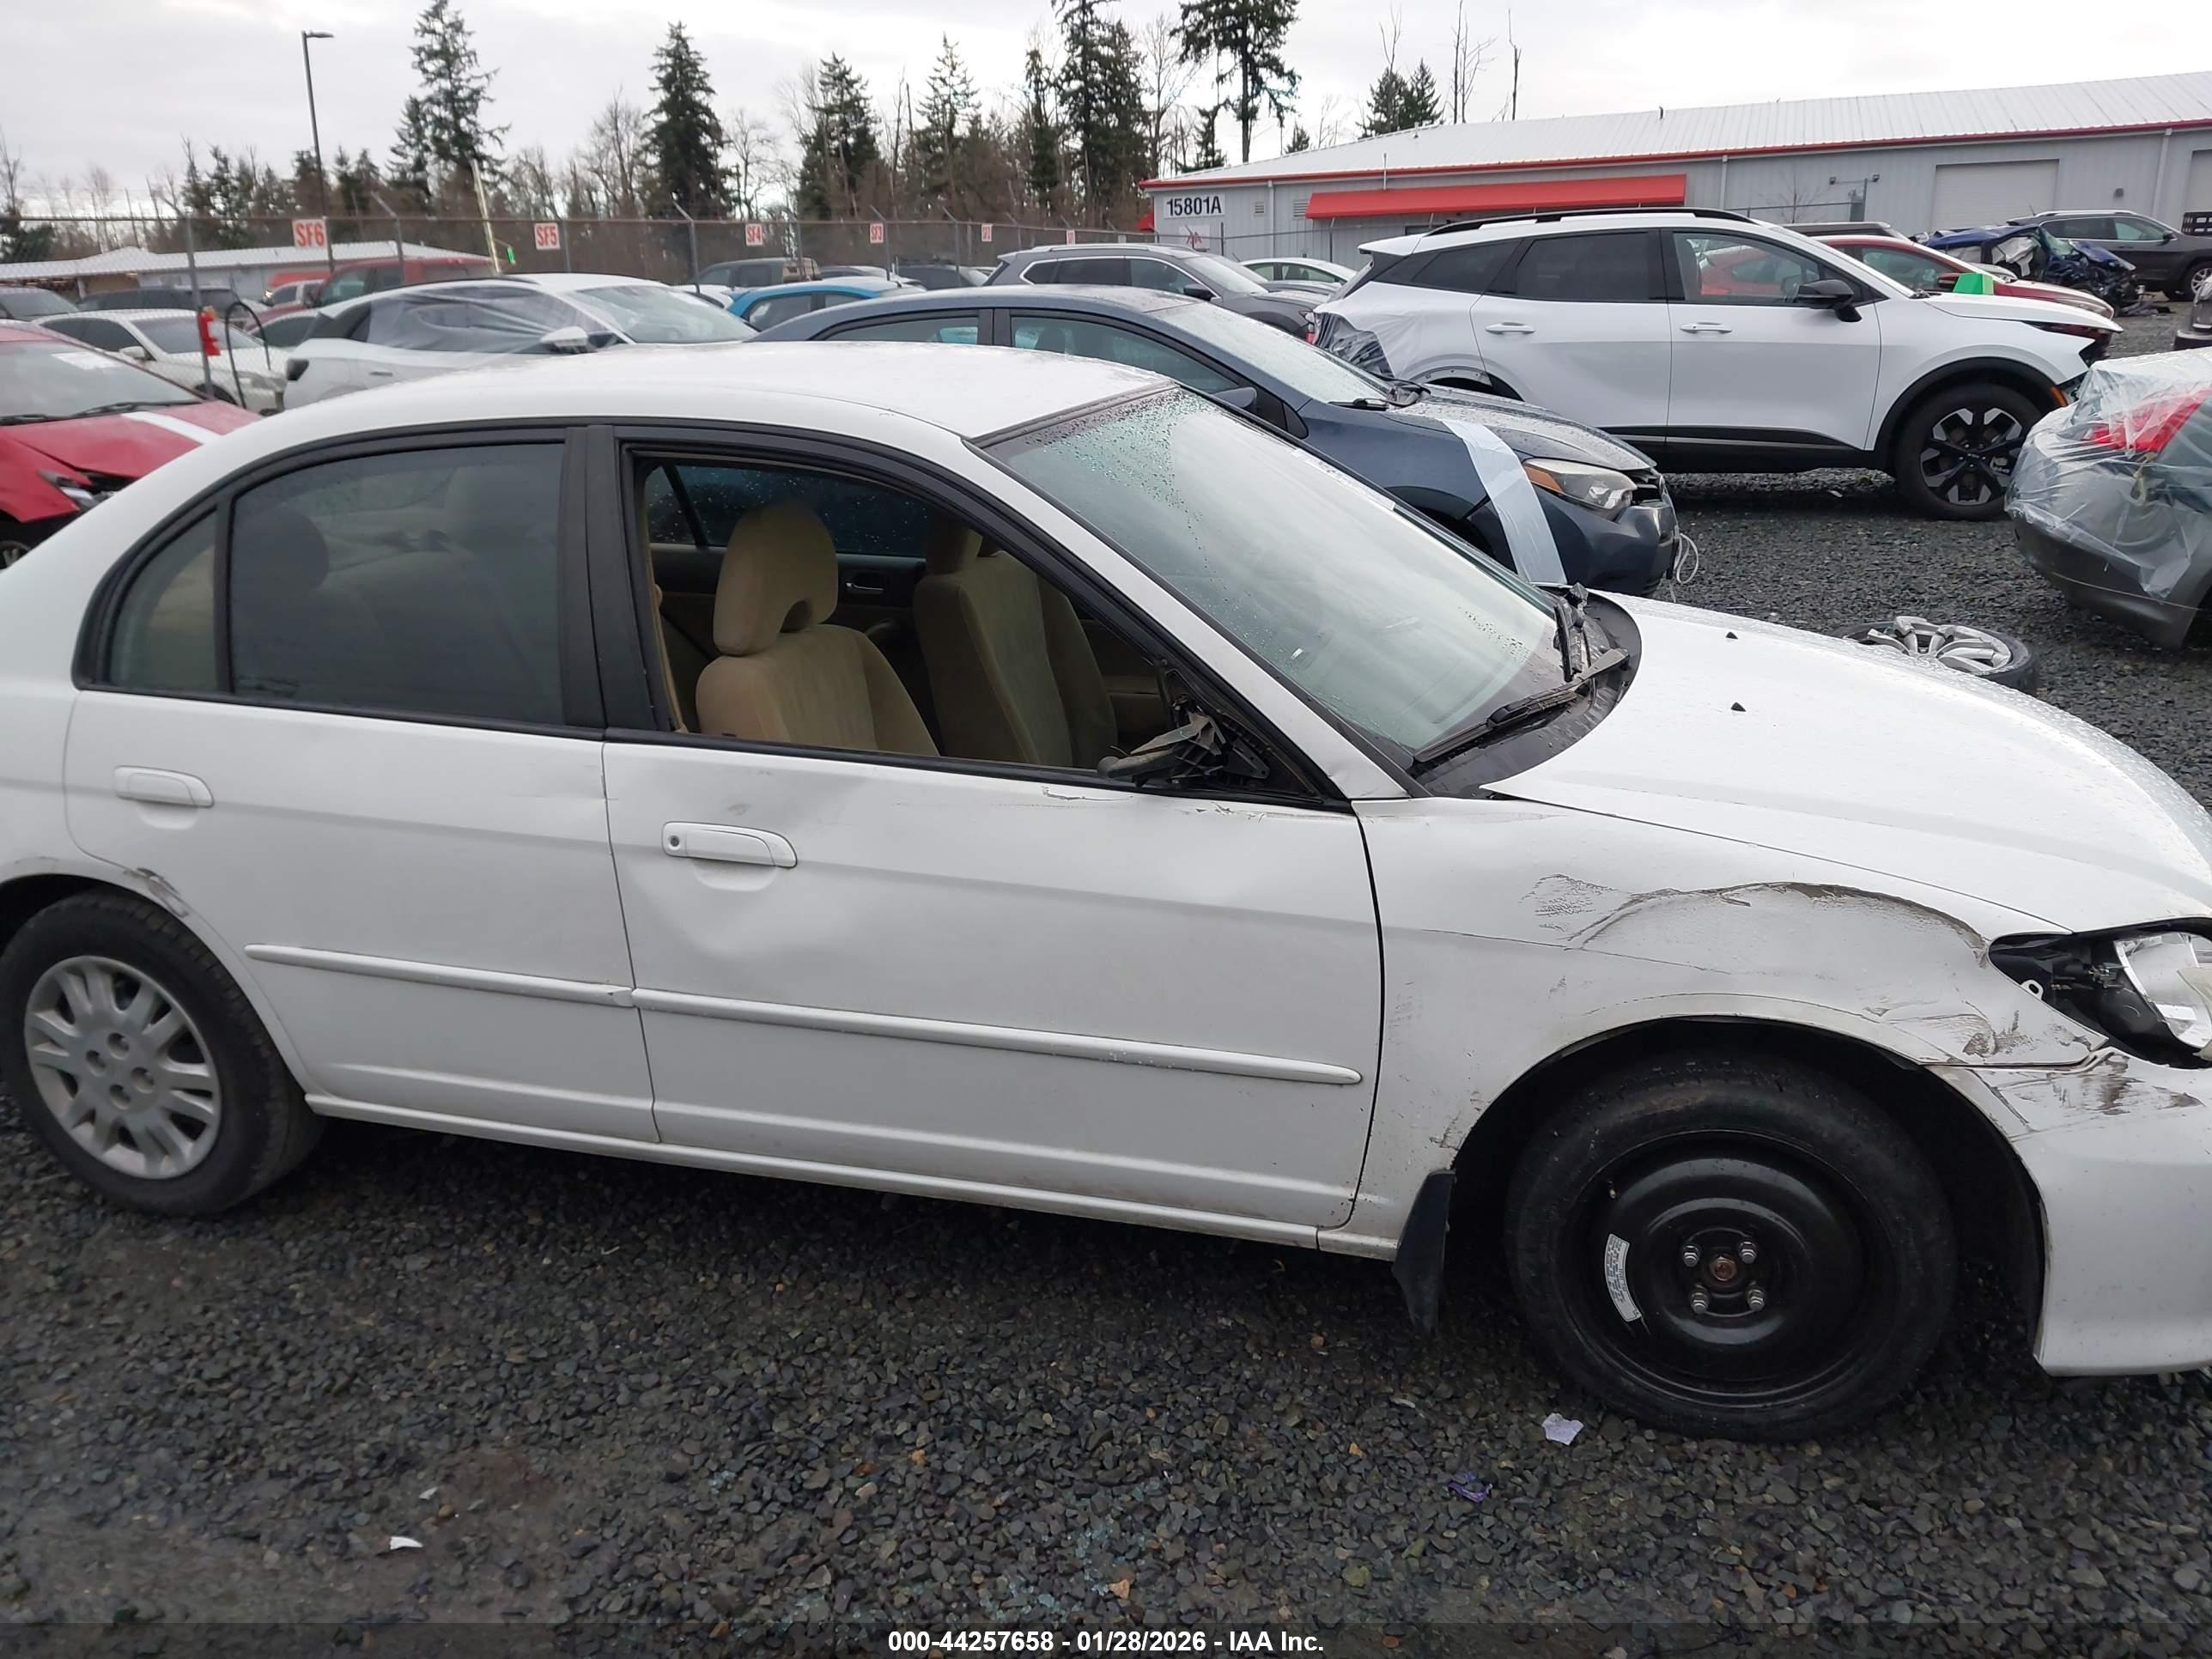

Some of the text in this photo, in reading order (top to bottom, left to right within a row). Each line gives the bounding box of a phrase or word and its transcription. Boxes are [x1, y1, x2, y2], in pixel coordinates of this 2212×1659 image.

[1166, 196, 1222, 216] 15801A
[295, 222, 325, 247] SF6
[536, 225, 557, 246] SF5
[747, 226, 761, 242] SF4
